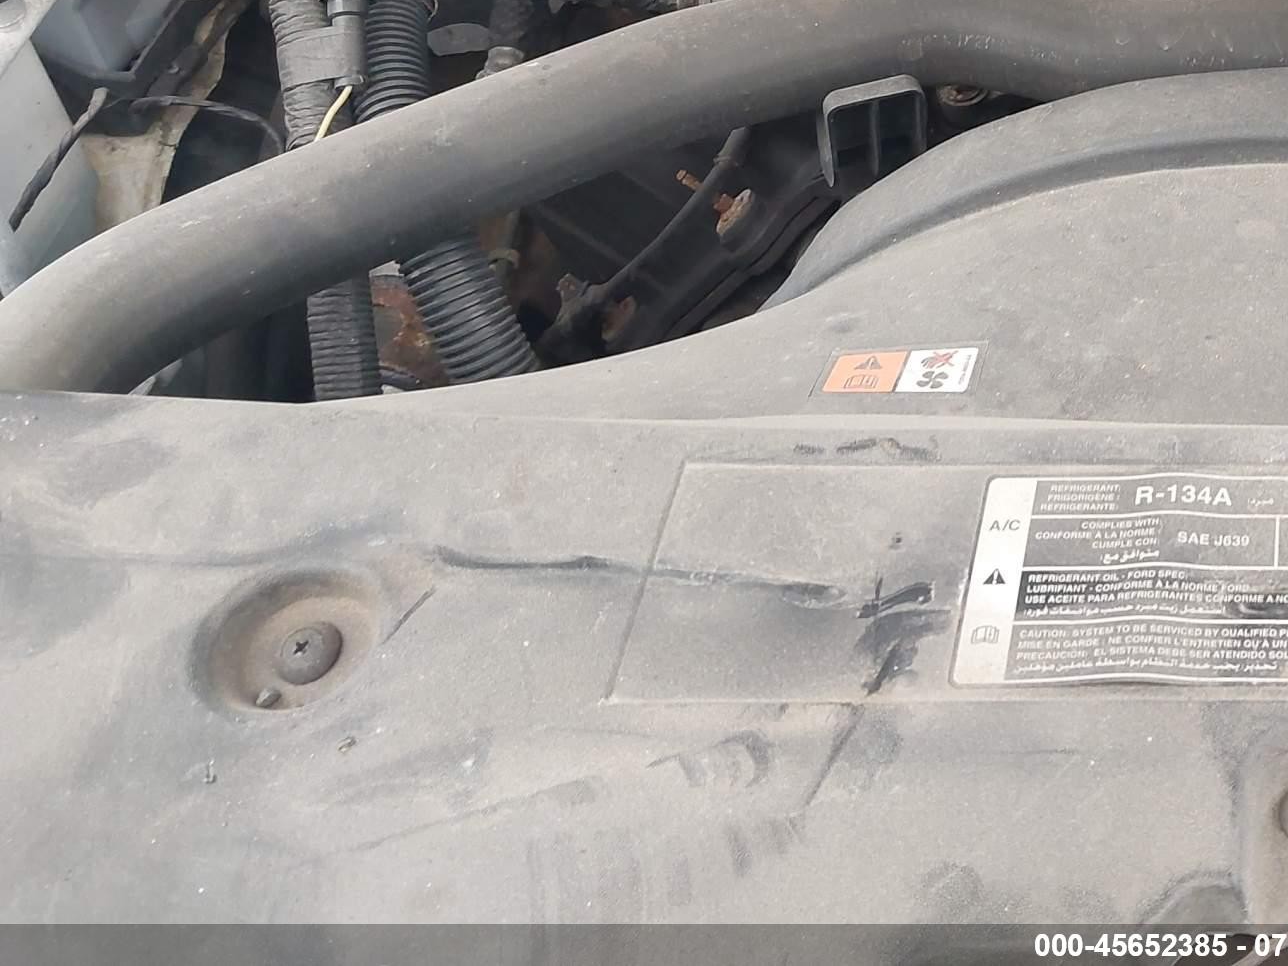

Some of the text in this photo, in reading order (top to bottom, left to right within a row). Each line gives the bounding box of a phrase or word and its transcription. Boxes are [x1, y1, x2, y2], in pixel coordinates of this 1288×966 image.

[1134, 484, 1232, 506] R-134A
[989, 519, 1021, 532] A/C
[1081, 520, 1133, 530] COMPLIES
[1035, 531, 1092, 540] CONFORME
[1104, 531, 1118, 539] LA
[1120, 527, 1156, 538] NORME
[1177, 531, 1250, 547] SAE J639
[1092, 541, 1133, 549] CUMPLE
[1028, 573, 1100, 583] REFRIGERANT
[1102, 572, 1119, 582] OIL
[1127, 569, 1156, 580] FORD
[1026, 584, 1087, 594] LUBRIFIANT
[1095, 579, 1153, 593] CONFORME
[1164, 580, 1179, 589] LA
[1180, 581, 1218, 593] NORME
[1024, 595, 1046, 604] USE
[1047, 594, 1086, 604] ACEITE
[1087, 593, 1115, 603] PARA
[1117, 590, 1203, 602] REFRIGERANTES
[1205, 594, 1264, 603] CONFORME
[1072, 626, 1114, 638] SYSTEM
[1116, 624, 1131, 634] TO
[1132, 623, 1147, 634] BE
[1150, 624, 1202, 637] SERVICED
[1204, 628, 1219, 637] BY
[1221, 628, 1277, 638] QUALIFIED
[1017, 640, 1043, 650] MISE
[1046, 640, 1060, 649] EN
[1062, 638, 1100, 649] GARDE
[1108, 636, 1122, 645] NE
[1124, 635, 1171, 645] CONFIER
[1272, 640, 1288, 649] UN
[1094, 648, 1107, 657] EL
[1110, 645, 1156, 656] SISTEMA
[1157, 646, 1186, 658] DEBE
[1189, 649, 1211, 659] SER
[1213, 649, 1267, 660] ATENDIDO
